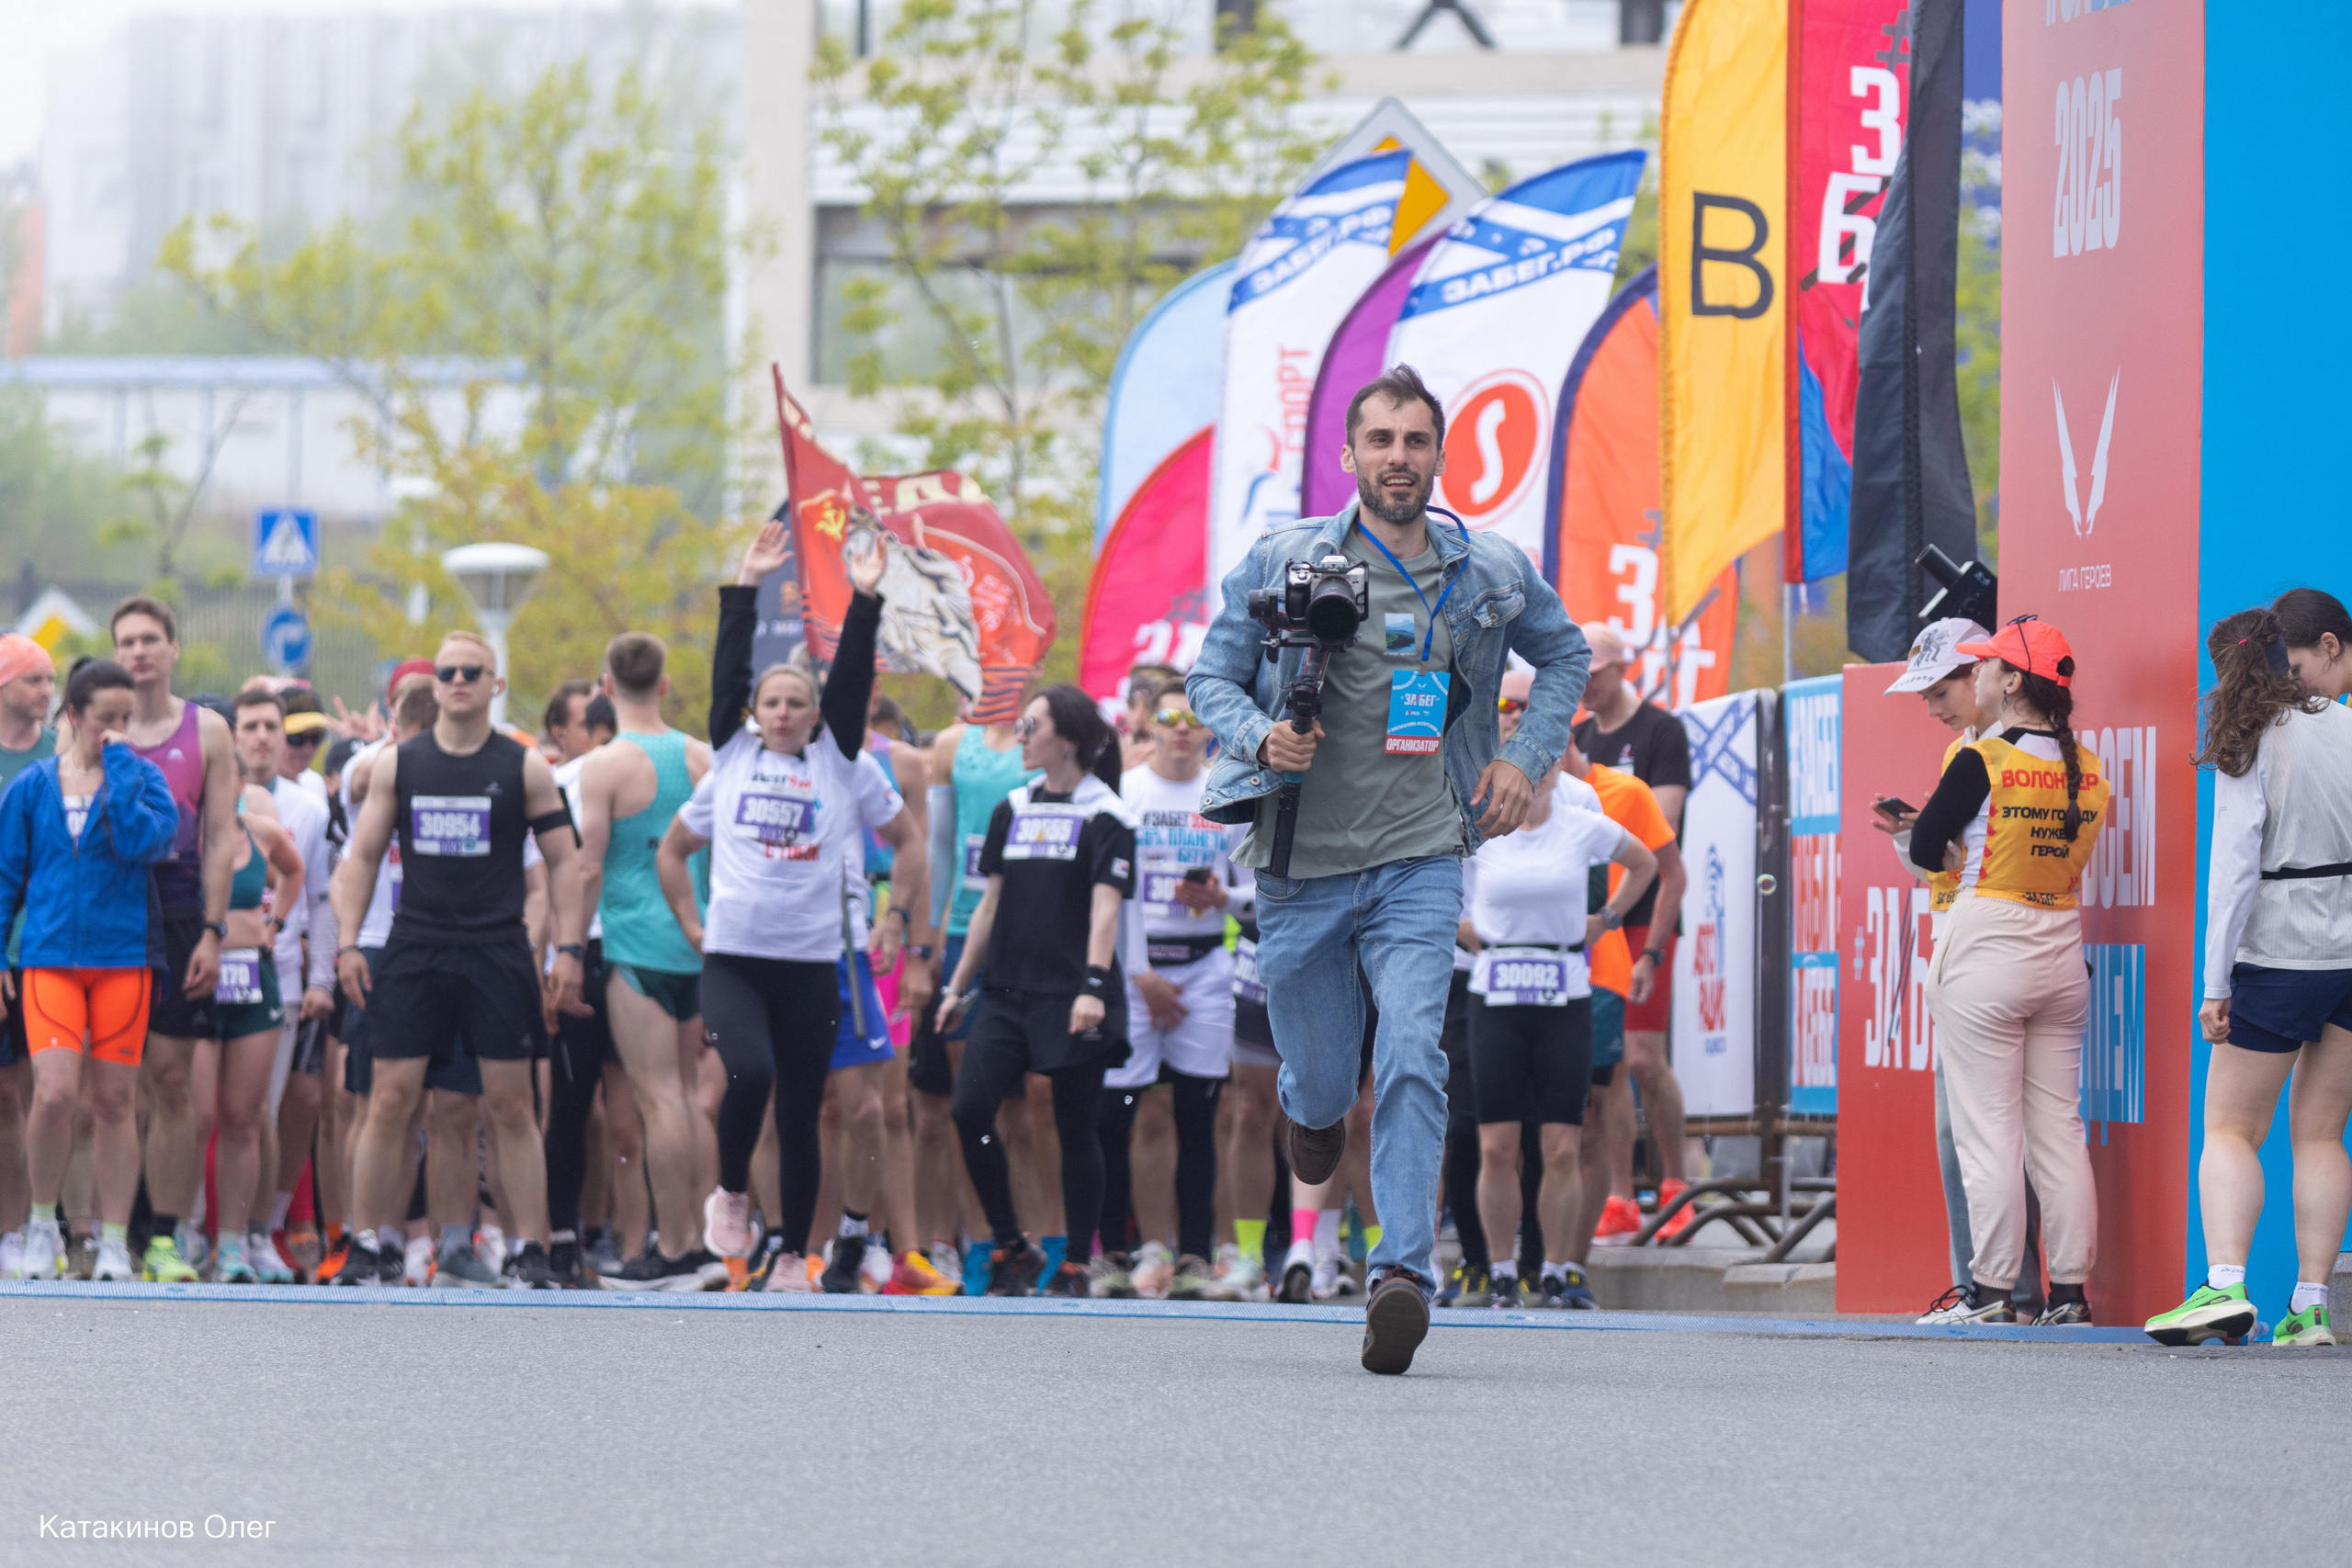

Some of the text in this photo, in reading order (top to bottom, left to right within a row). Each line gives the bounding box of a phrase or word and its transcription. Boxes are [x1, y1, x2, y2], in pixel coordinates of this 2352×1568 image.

[2052, 67, 2122, 259] 2025
[1441, 227, 1617, 303] ЗАБЕГ.РФ
[2057, 563, 2112, 592] ЛИГА ГЕРОЕВ
[1419, 694, 1437, 707] БЕГ
[1385, 738, 1440, 752] ОРГАНИЗАТОР
[2001, 769, 2099, 791] ВОЛОНЕР
[419, 810, 482, 840] 30954
[2002, 806, 2098, 824] ЭТОМУ ГОДУ
[2030, 826, 2067, 840] НУЖЕ
[2030, 844, 2070, 858] ГЕРОЙ
[1494, 962, 1560, 988] 30092
